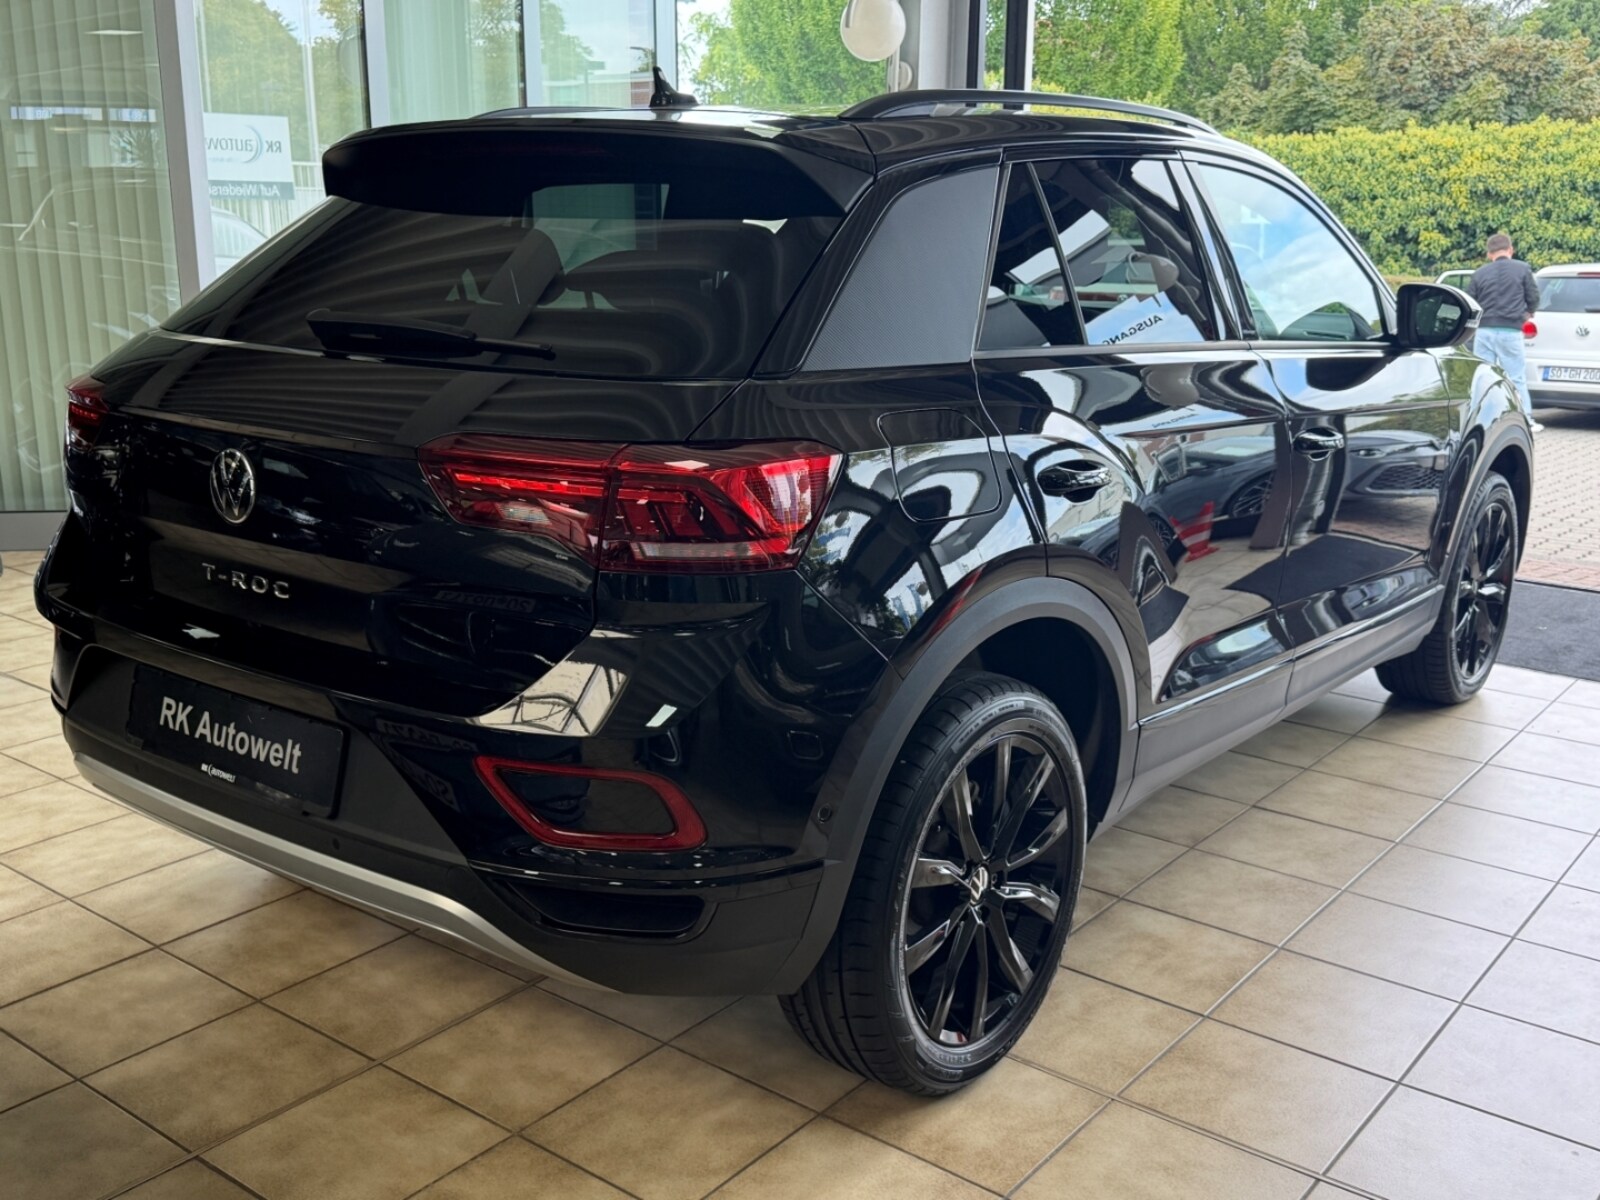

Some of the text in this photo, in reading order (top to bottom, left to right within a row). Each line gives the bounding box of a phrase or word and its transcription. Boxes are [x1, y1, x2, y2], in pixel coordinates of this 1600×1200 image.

[201, 562, 290, 599] T-ROC
[159, 696, 302, 774] RK Autowelt
